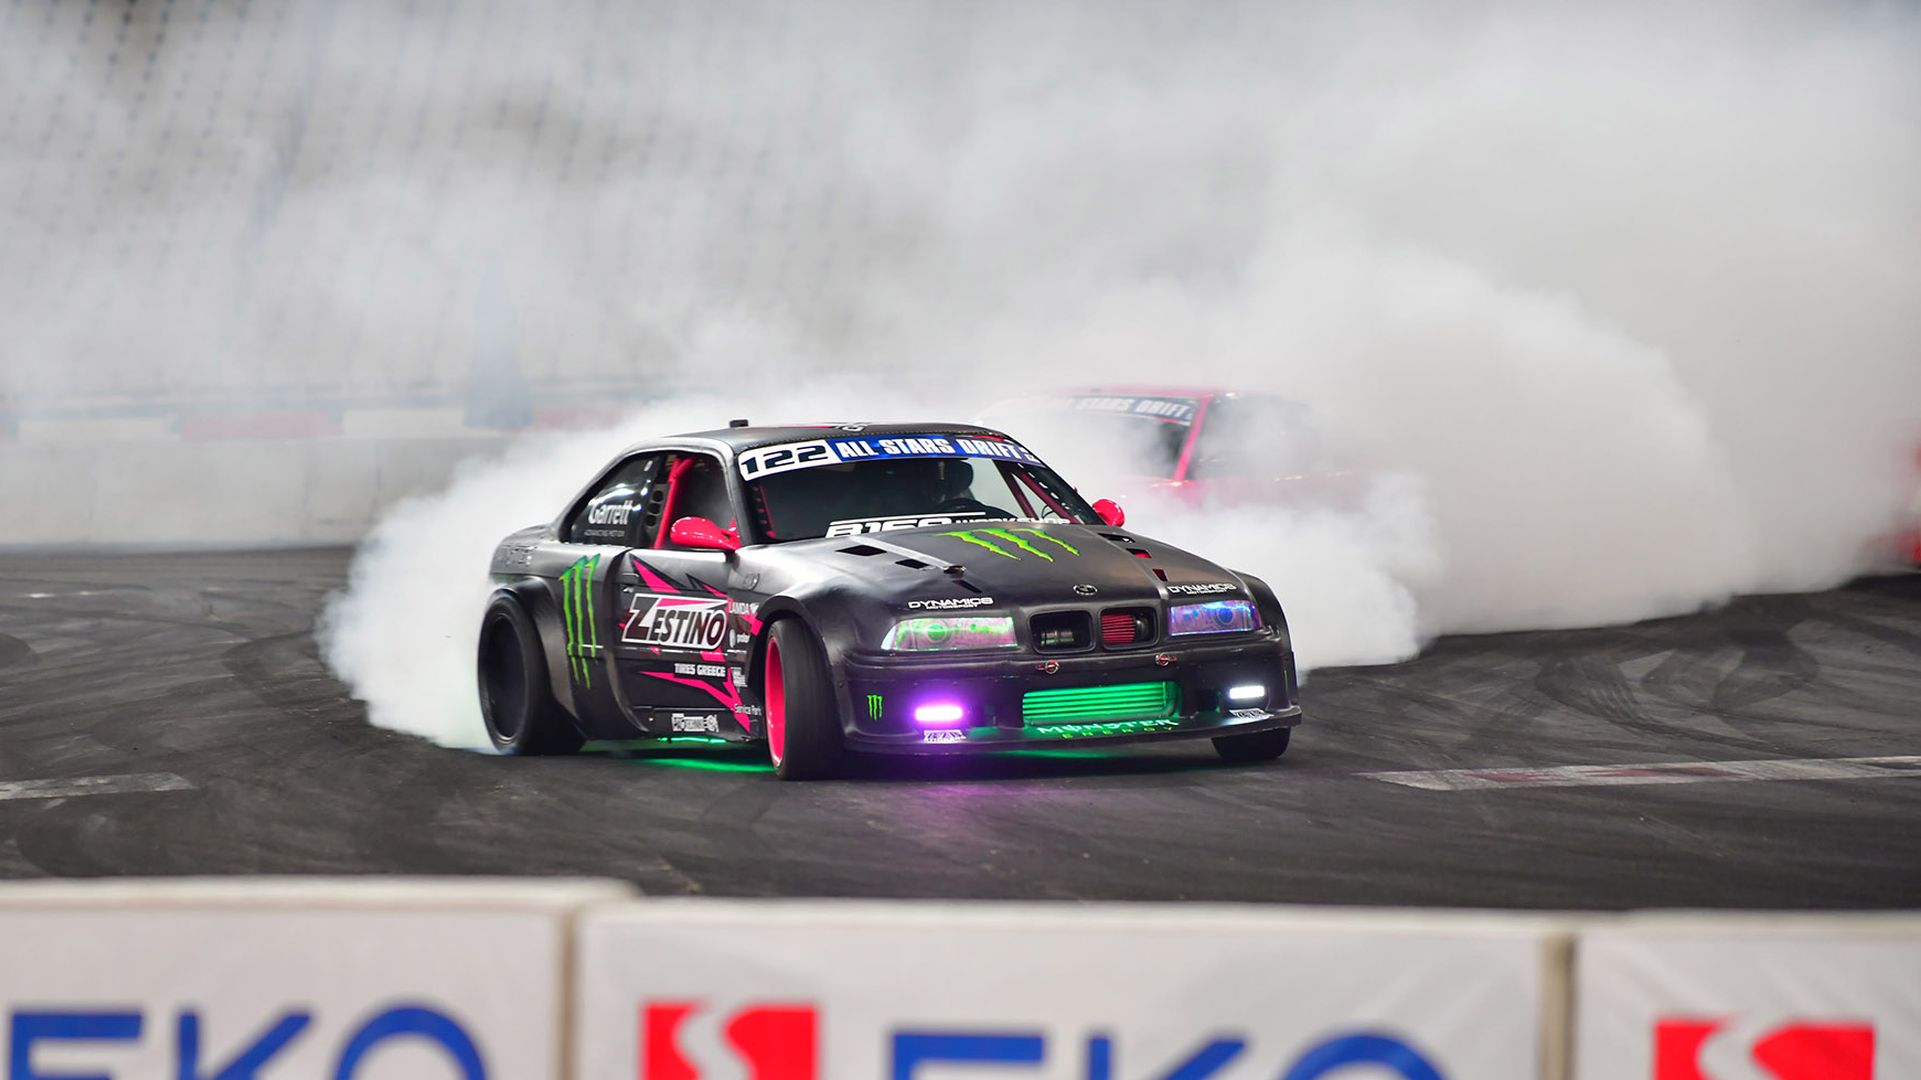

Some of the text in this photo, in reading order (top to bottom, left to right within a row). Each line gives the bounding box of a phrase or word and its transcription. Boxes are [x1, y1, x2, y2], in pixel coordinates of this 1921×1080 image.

[835, 440, 880, 458] ALL
[879, 438, 956, 455] STARS
[956, 438, 1022, 460] DRIFT
[741, 444, 828, 474] 122
[588, 501, 633, 525] Garrett
[1167, 583, 1237, 593] DYNAMICS
[908, 597, 994, 609] DYNAMICS
[621, 593, 729, 649] ZESTINO
[697, 664, 726, 677] GREECE
[1061, 726, 1173, 740] ENERGY
